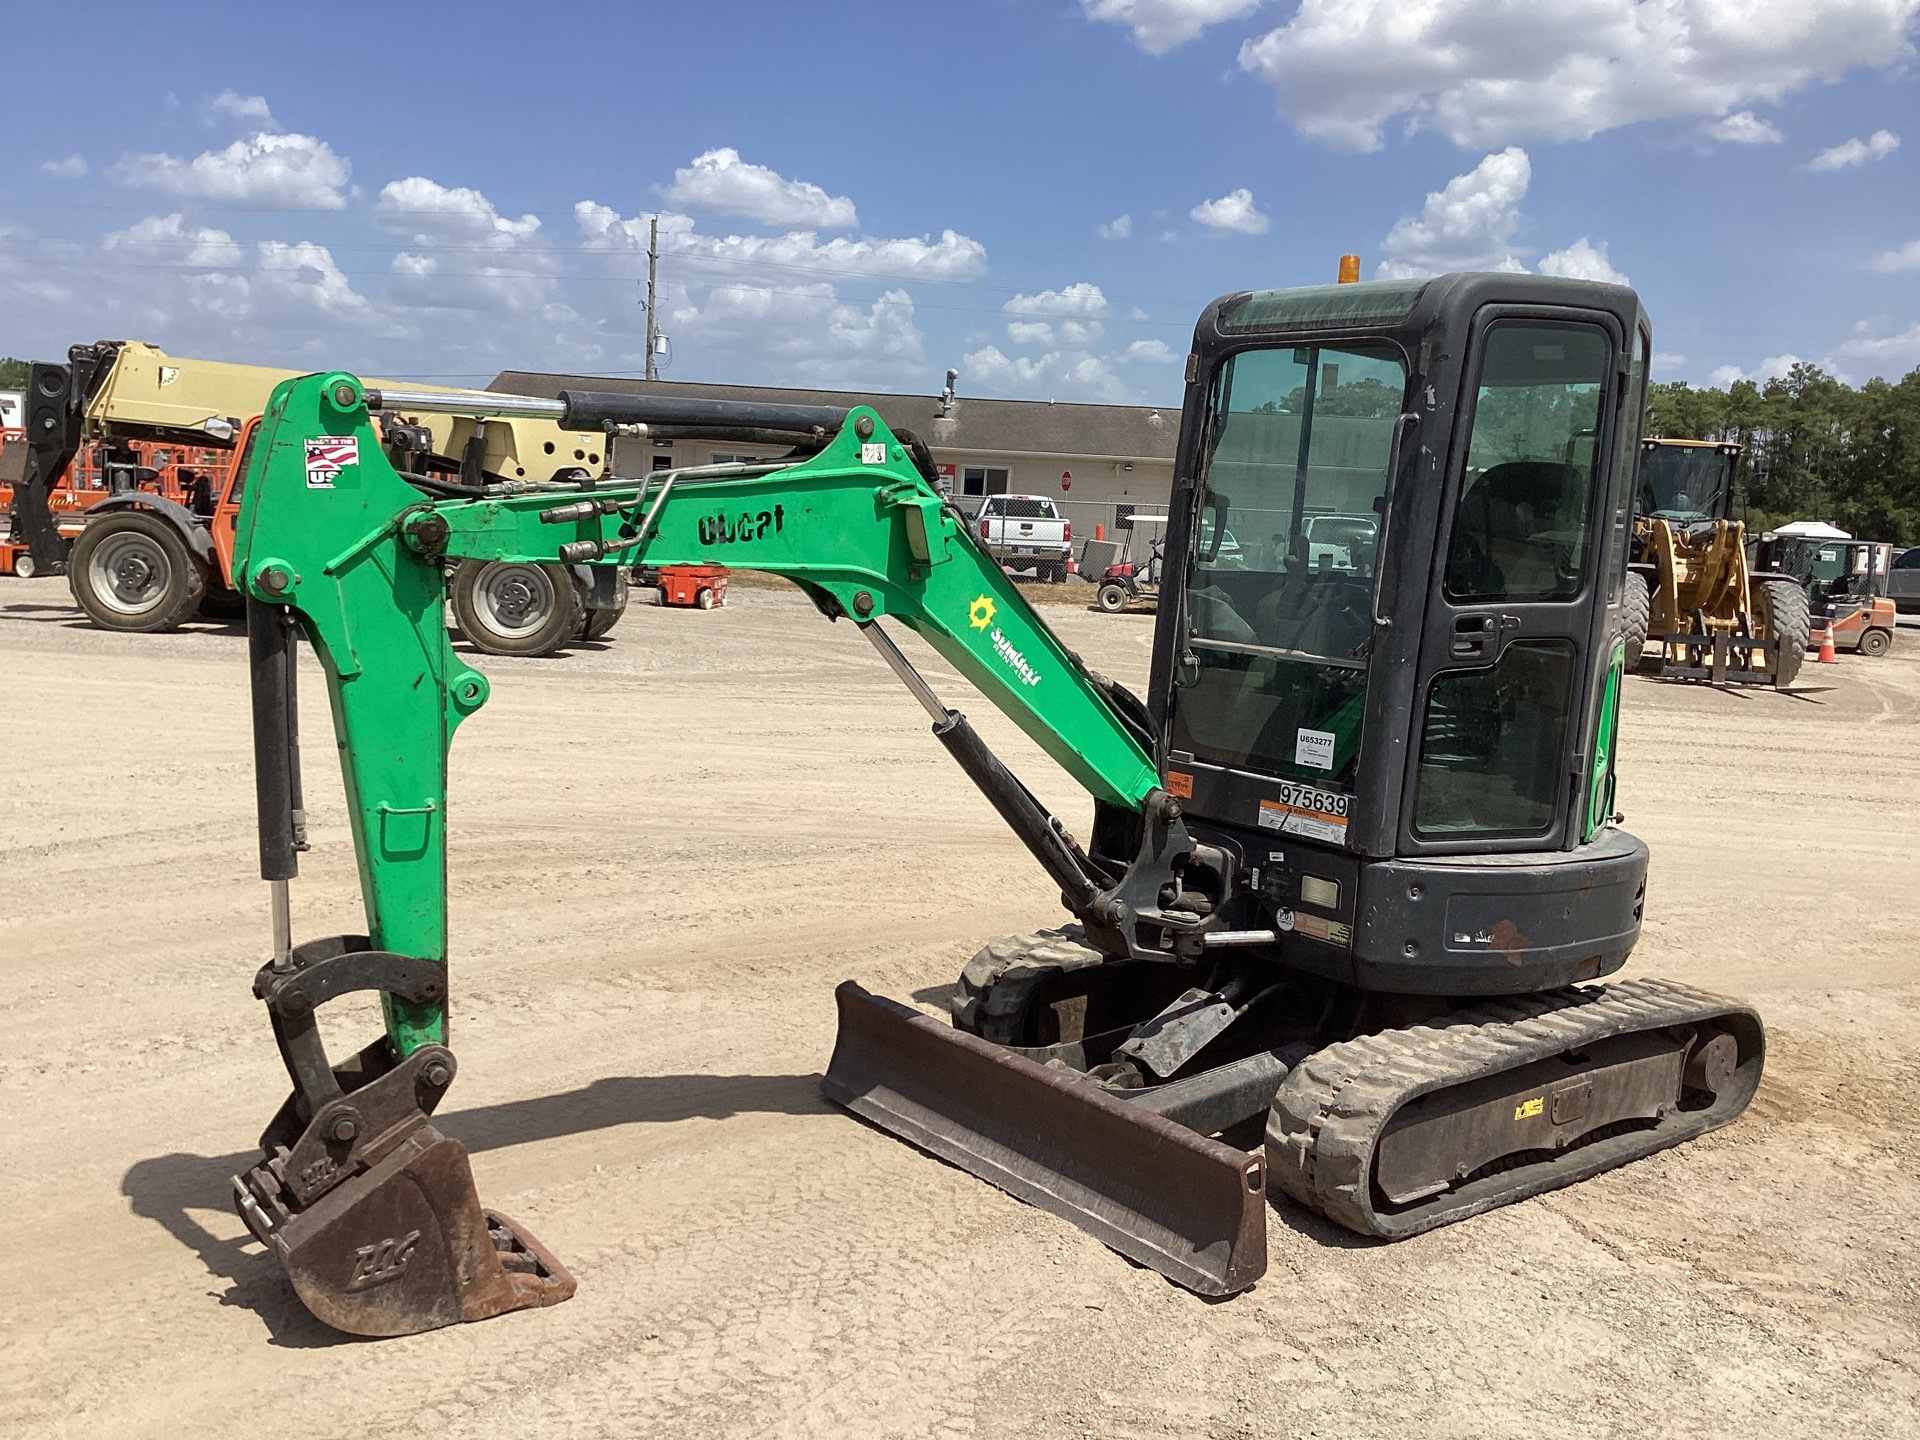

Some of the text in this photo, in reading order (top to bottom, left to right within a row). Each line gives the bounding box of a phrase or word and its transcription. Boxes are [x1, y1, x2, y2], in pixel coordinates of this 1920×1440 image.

[1300, 735, 1332, 747] U653277
[1281, 786, 1347, 816] 975639
[1293, 808, 1319, 819] WARNING
